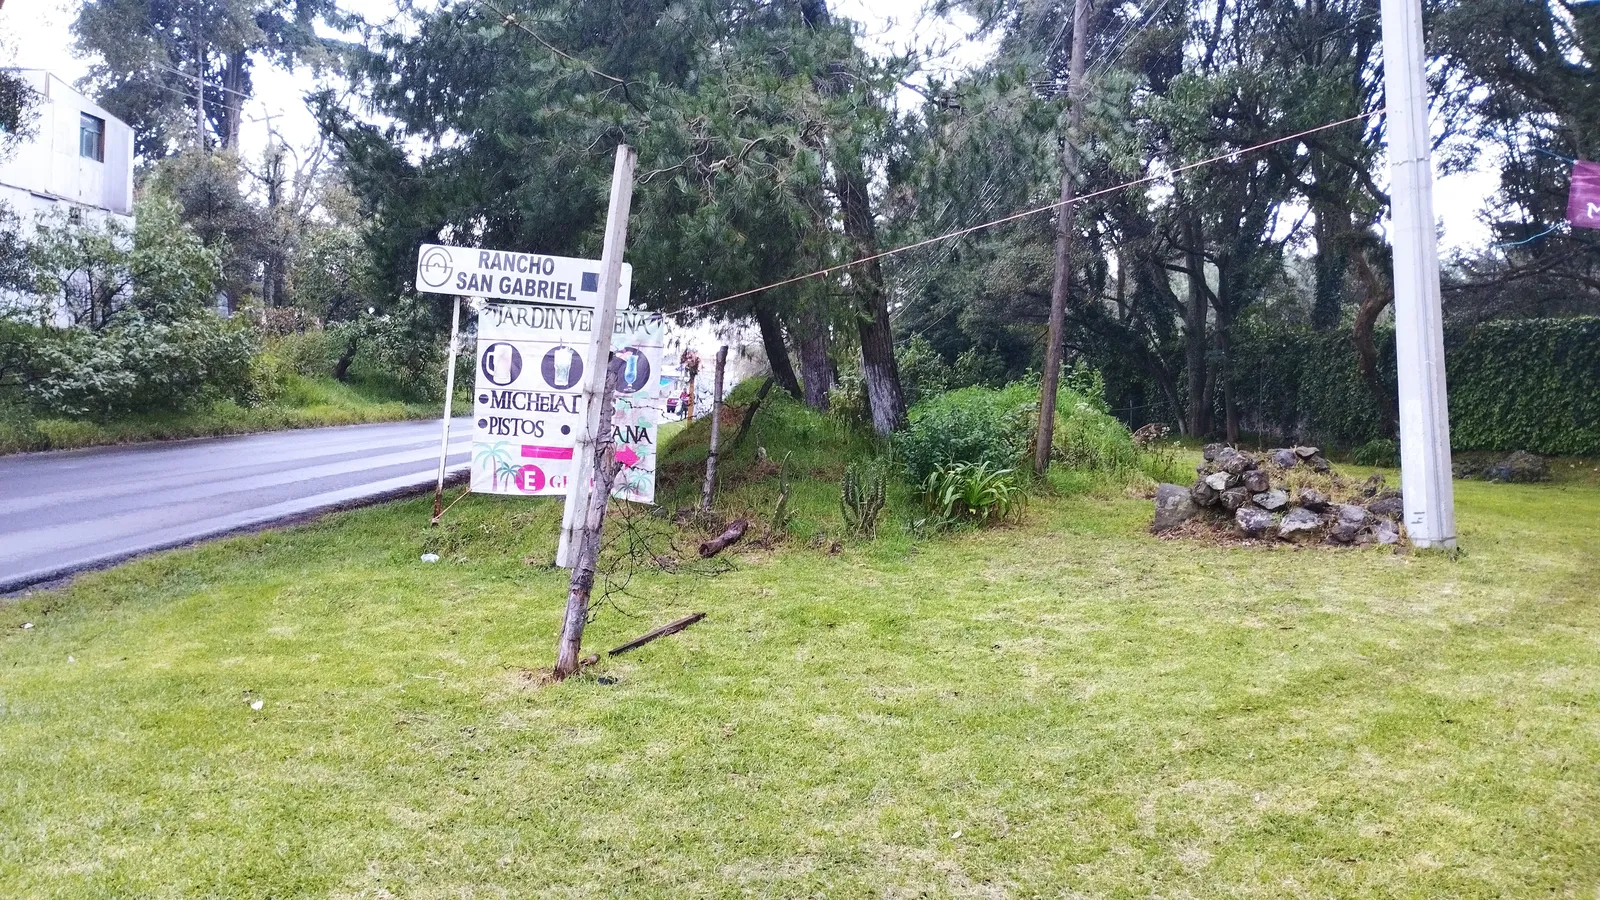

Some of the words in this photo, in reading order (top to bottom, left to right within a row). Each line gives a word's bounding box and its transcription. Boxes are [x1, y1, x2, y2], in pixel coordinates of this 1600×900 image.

[478, 250, 555, 276] RANCHO
[456, 271, 494, 293] SAN
[498, 276, 577, 301] GABRIEL
[496, 305, 565, 330] JARDIN
[567, 308, 651, 335] VEENA
[489, 390, 582, 414] MICHELA
[488, 416, 545, 438] PISTOS
[524, 470, 536, 491] E
